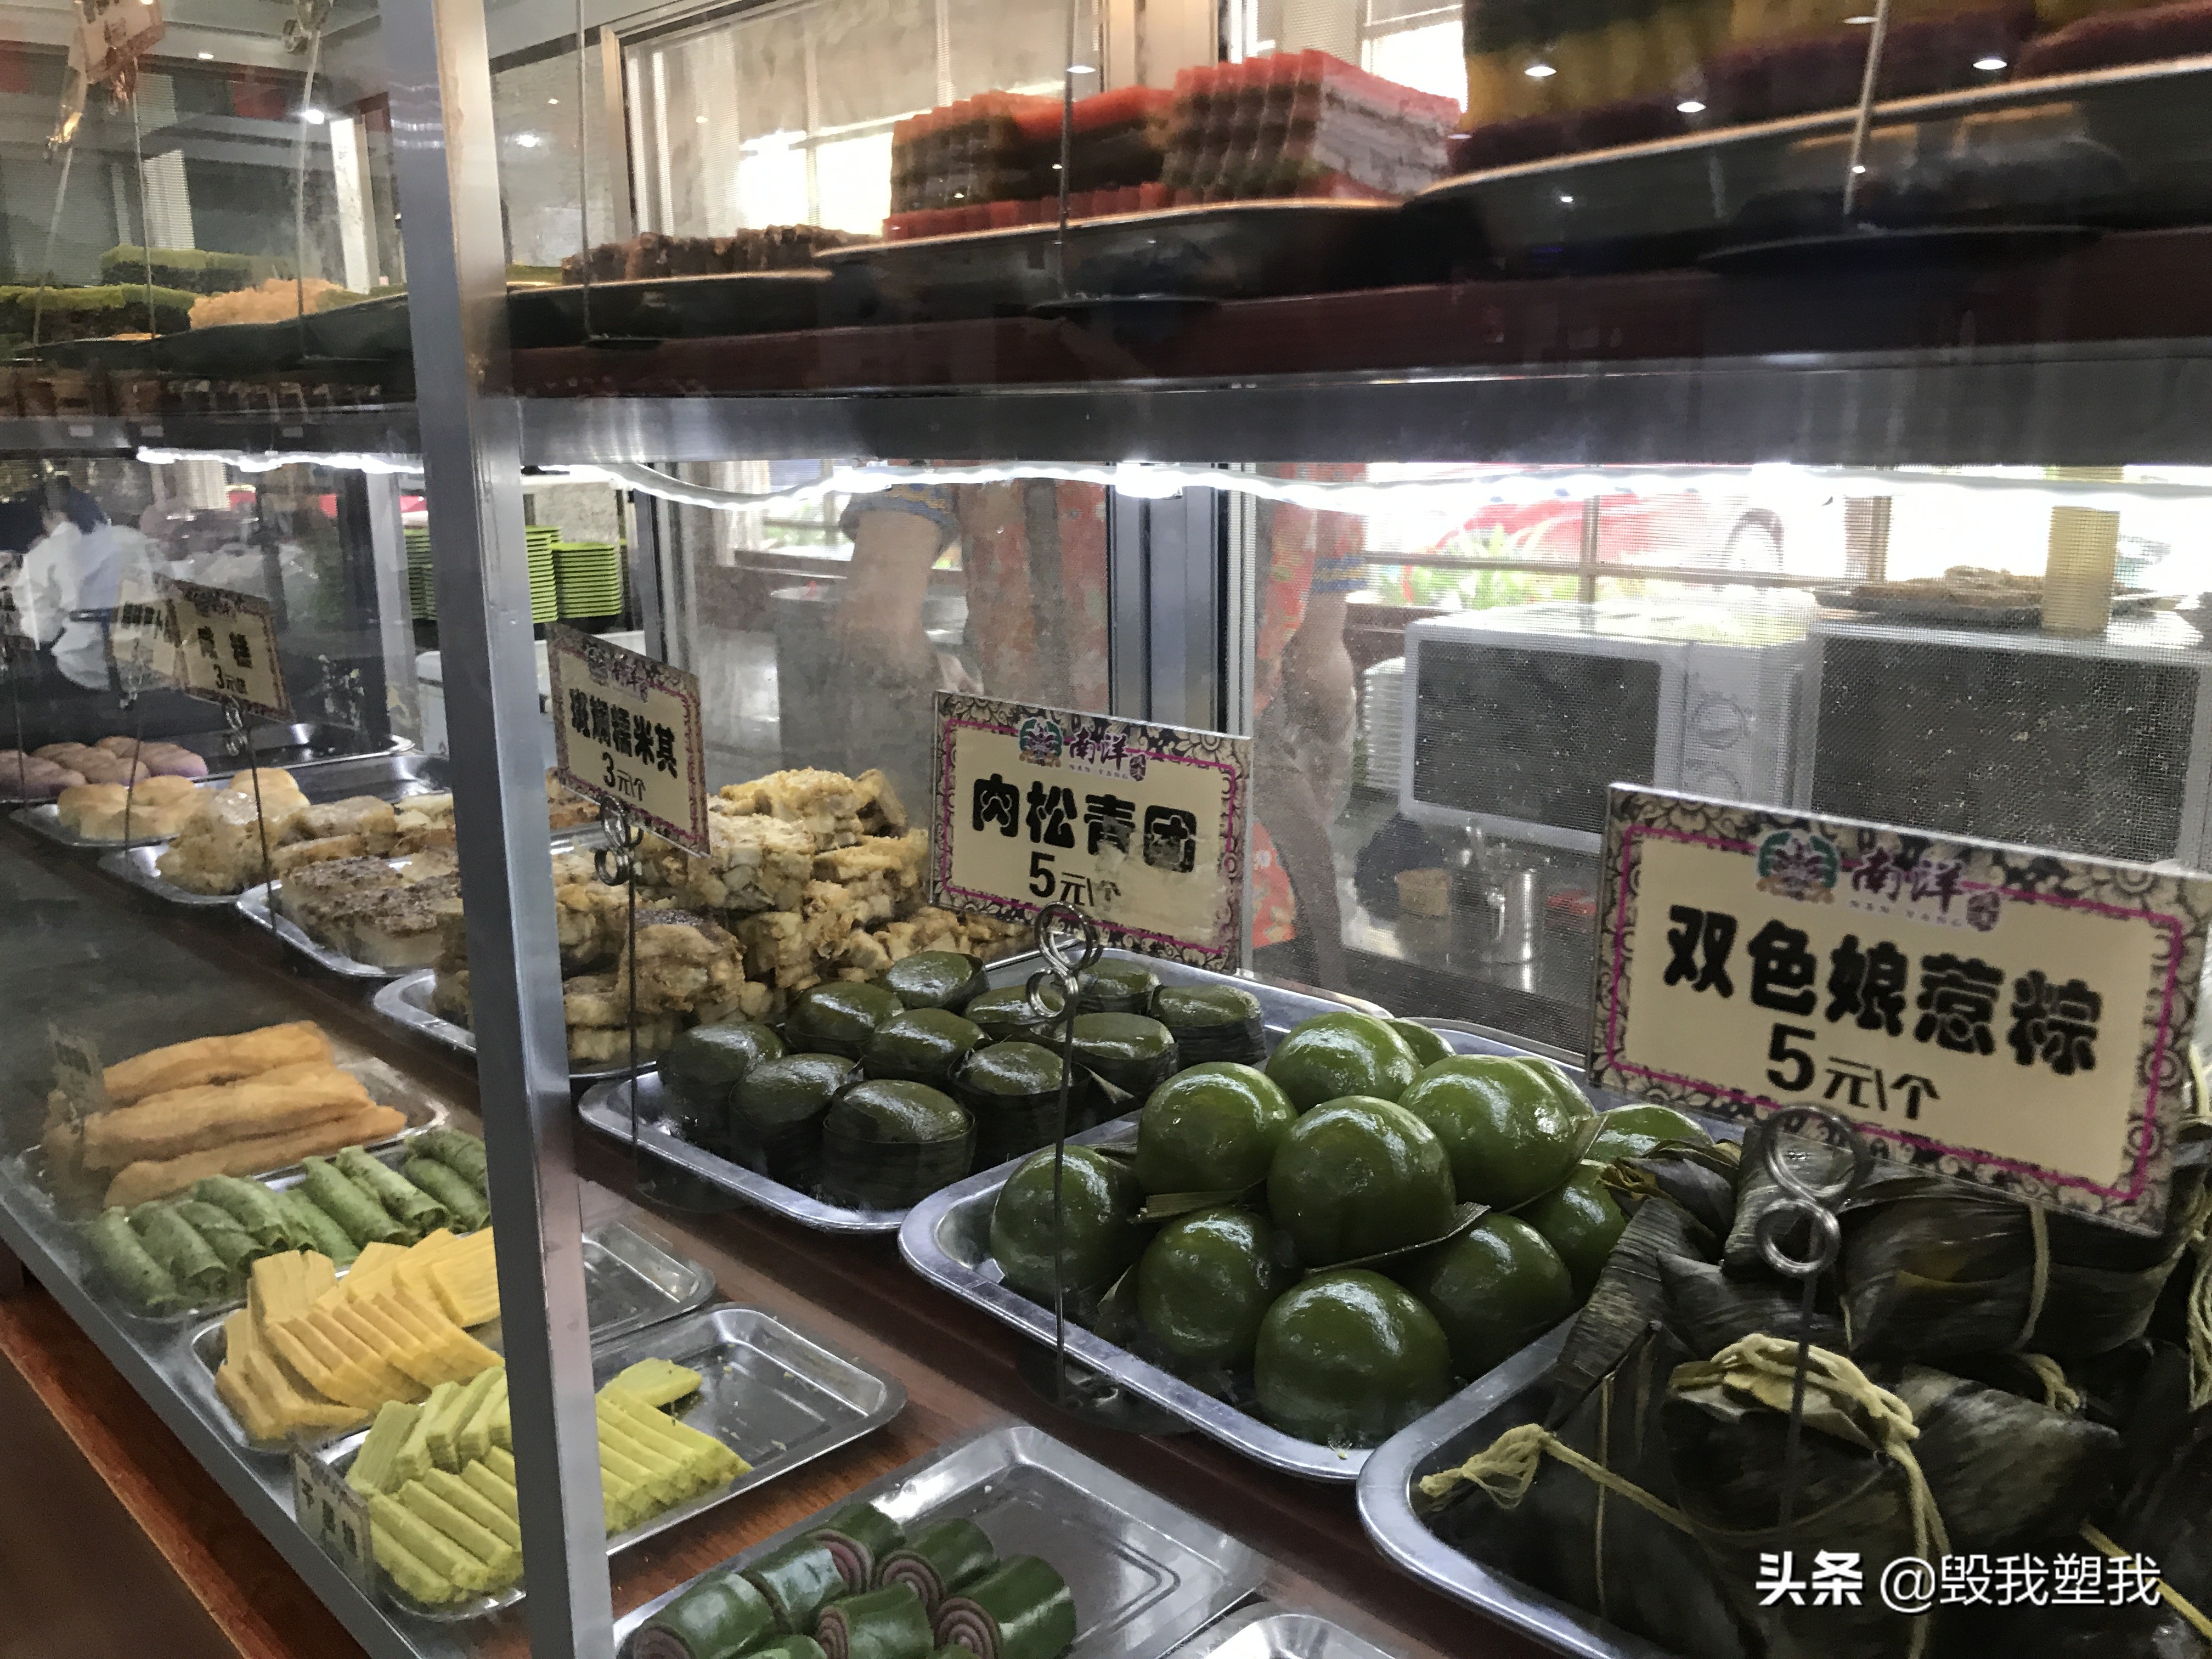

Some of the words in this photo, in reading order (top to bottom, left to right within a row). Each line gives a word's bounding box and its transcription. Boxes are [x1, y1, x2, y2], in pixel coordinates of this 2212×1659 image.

[1069, 727, 1128, 770] 南洋
[972, 774, 1197, 873] 肉松青团
[1852, 848, 1964, 913] 南洋
[1662, 904, 2102, 1075] 双色娘惹粽
